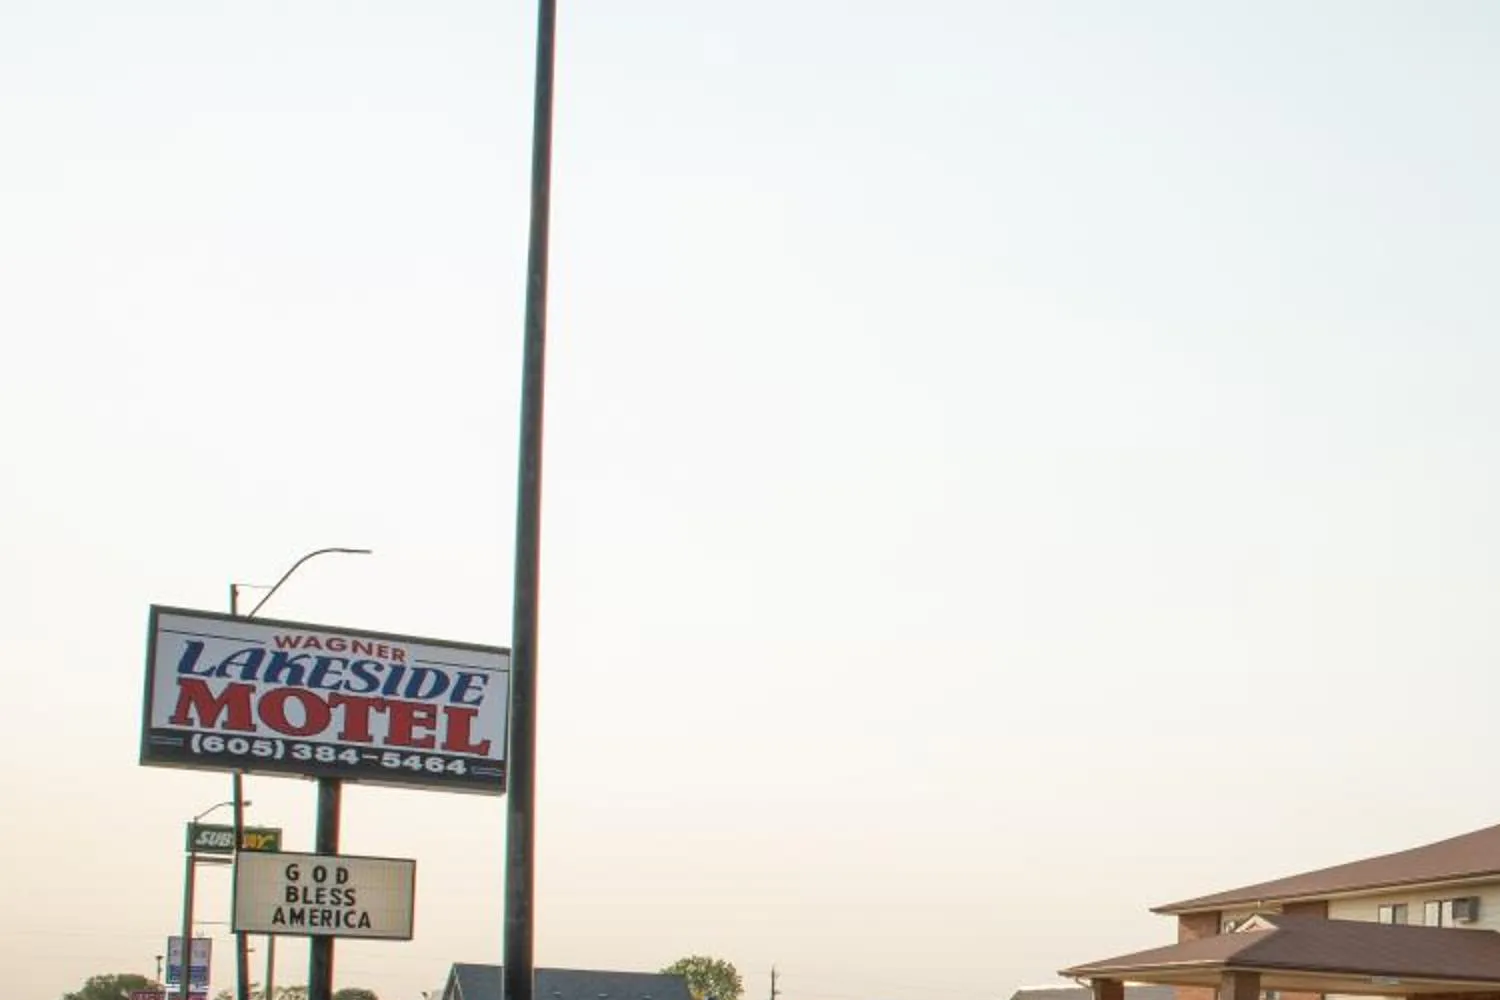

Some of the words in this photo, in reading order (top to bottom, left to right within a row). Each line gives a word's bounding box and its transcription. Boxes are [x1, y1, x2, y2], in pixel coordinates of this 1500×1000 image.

[273, 635, 406, 662] WAGNER
[177, 640, 489, 706] LAKESIDE
[168, 677, 491, 757] MOTEL
[191, 733, 285, 760] (605)
[291, 743, 467, 775] 384-5464
[196, 831, 275, 850] SUBAY
[285, 863, 350, 885] GOD
[285, 885, 357, 907] BLESS
[271, 906, 372, 929] AMERICA
